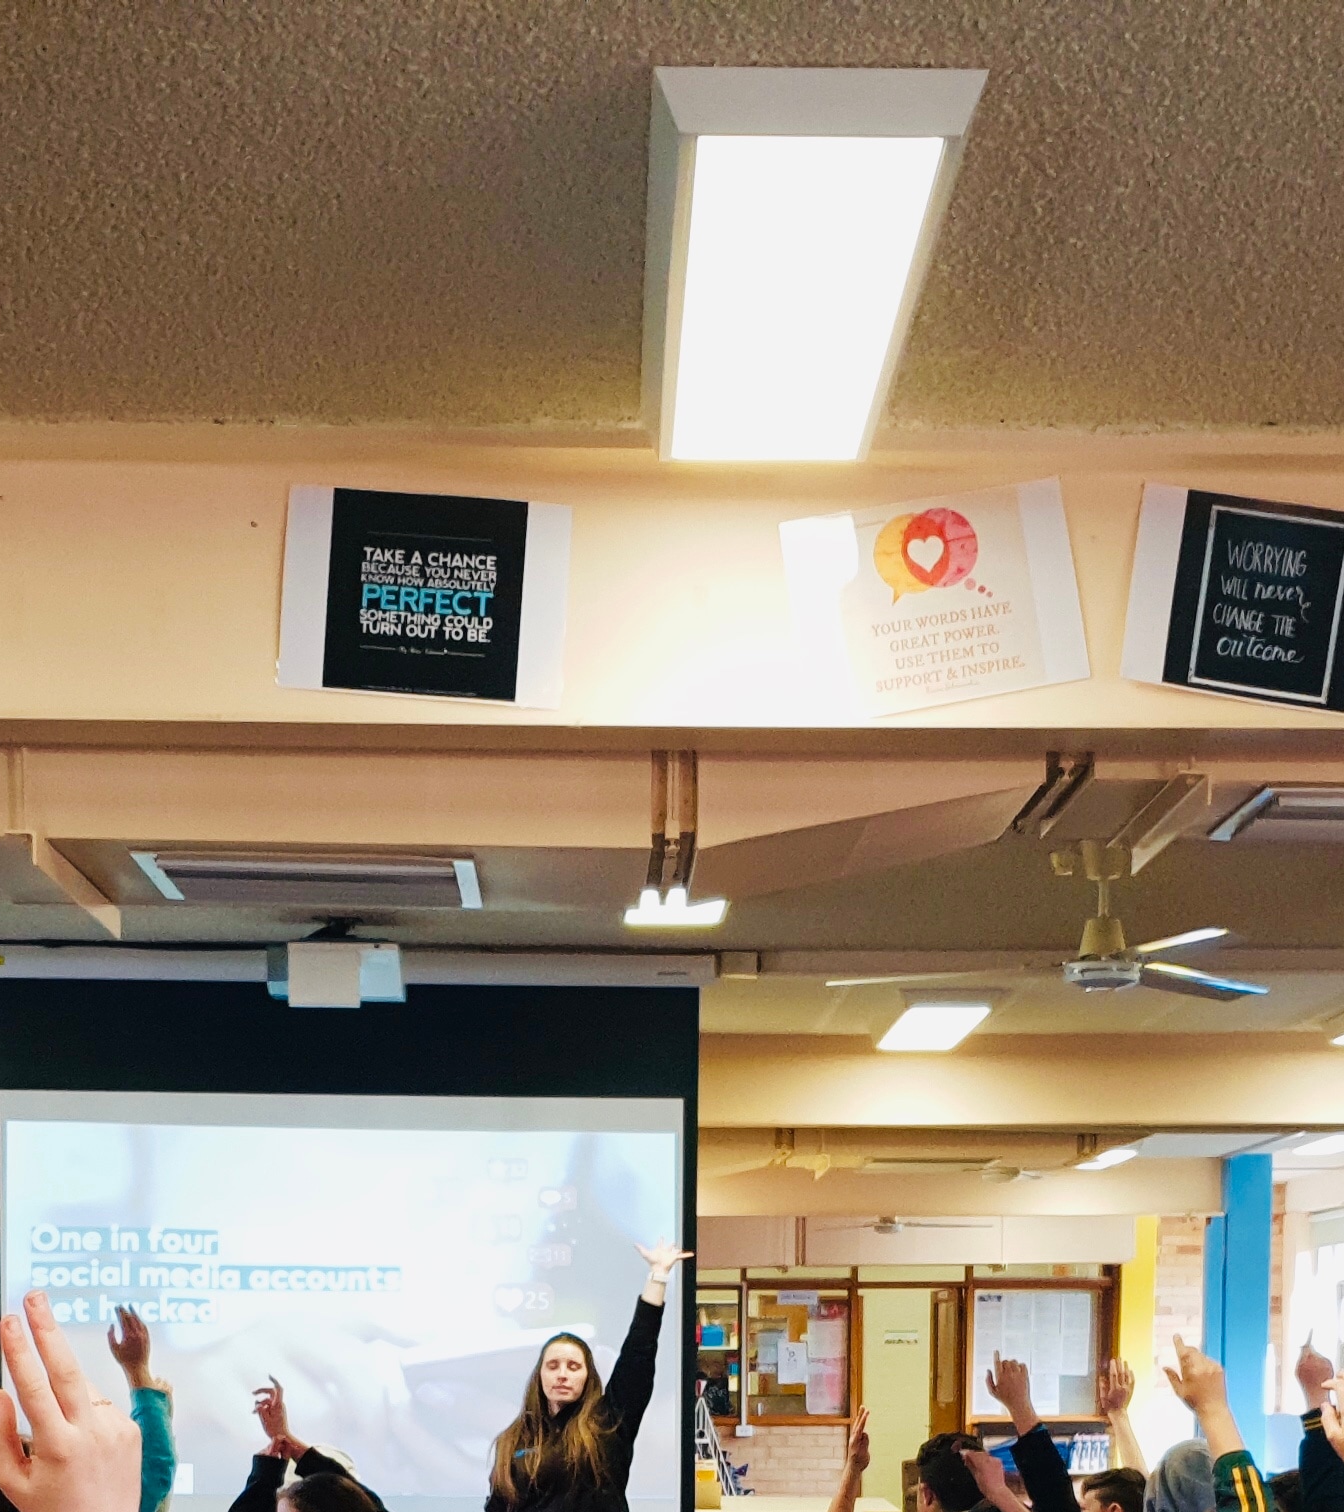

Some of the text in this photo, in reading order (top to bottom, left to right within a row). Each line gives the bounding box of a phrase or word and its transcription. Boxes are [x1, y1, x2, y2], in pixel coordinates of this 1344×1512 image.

[361, 561, 496, 581] BECAUSE YOU NEVER
[363, 546, 497, 570] TAKE A CHANCE
[1227, 539, 1307, 577] WORRYING
[360, 573, 496, 592] KNOW HOW ABSOLUTELY
[360, 582, 494, 616] PERFECT
[1220, 574, 1311, 623] WILL never
[359, 608, 493, 630] SOMETHING COULD
[360, 620, 491, 642] TURN OUT TO BE.
[870, 600, 1013, 637] YOUR WORDS HAVE
[1212, 602, 1297, 638] CHANGE THE
[889, 623, 1000, 653] GREAT POWER.
[894, 641, 1000, 669] USE THEM TO
[875, 669, 942, 692] SUPPORT
[946, 666, 958, 681] &
[959, 654, 1026, 677] INSPIRE.
[30, 1222, 220, 1255] One in four
[30, 1257, 401, 1293] social media accounts
[50, 1296, 91, 1324] et
[524, 1290, 550, 1311] 25
